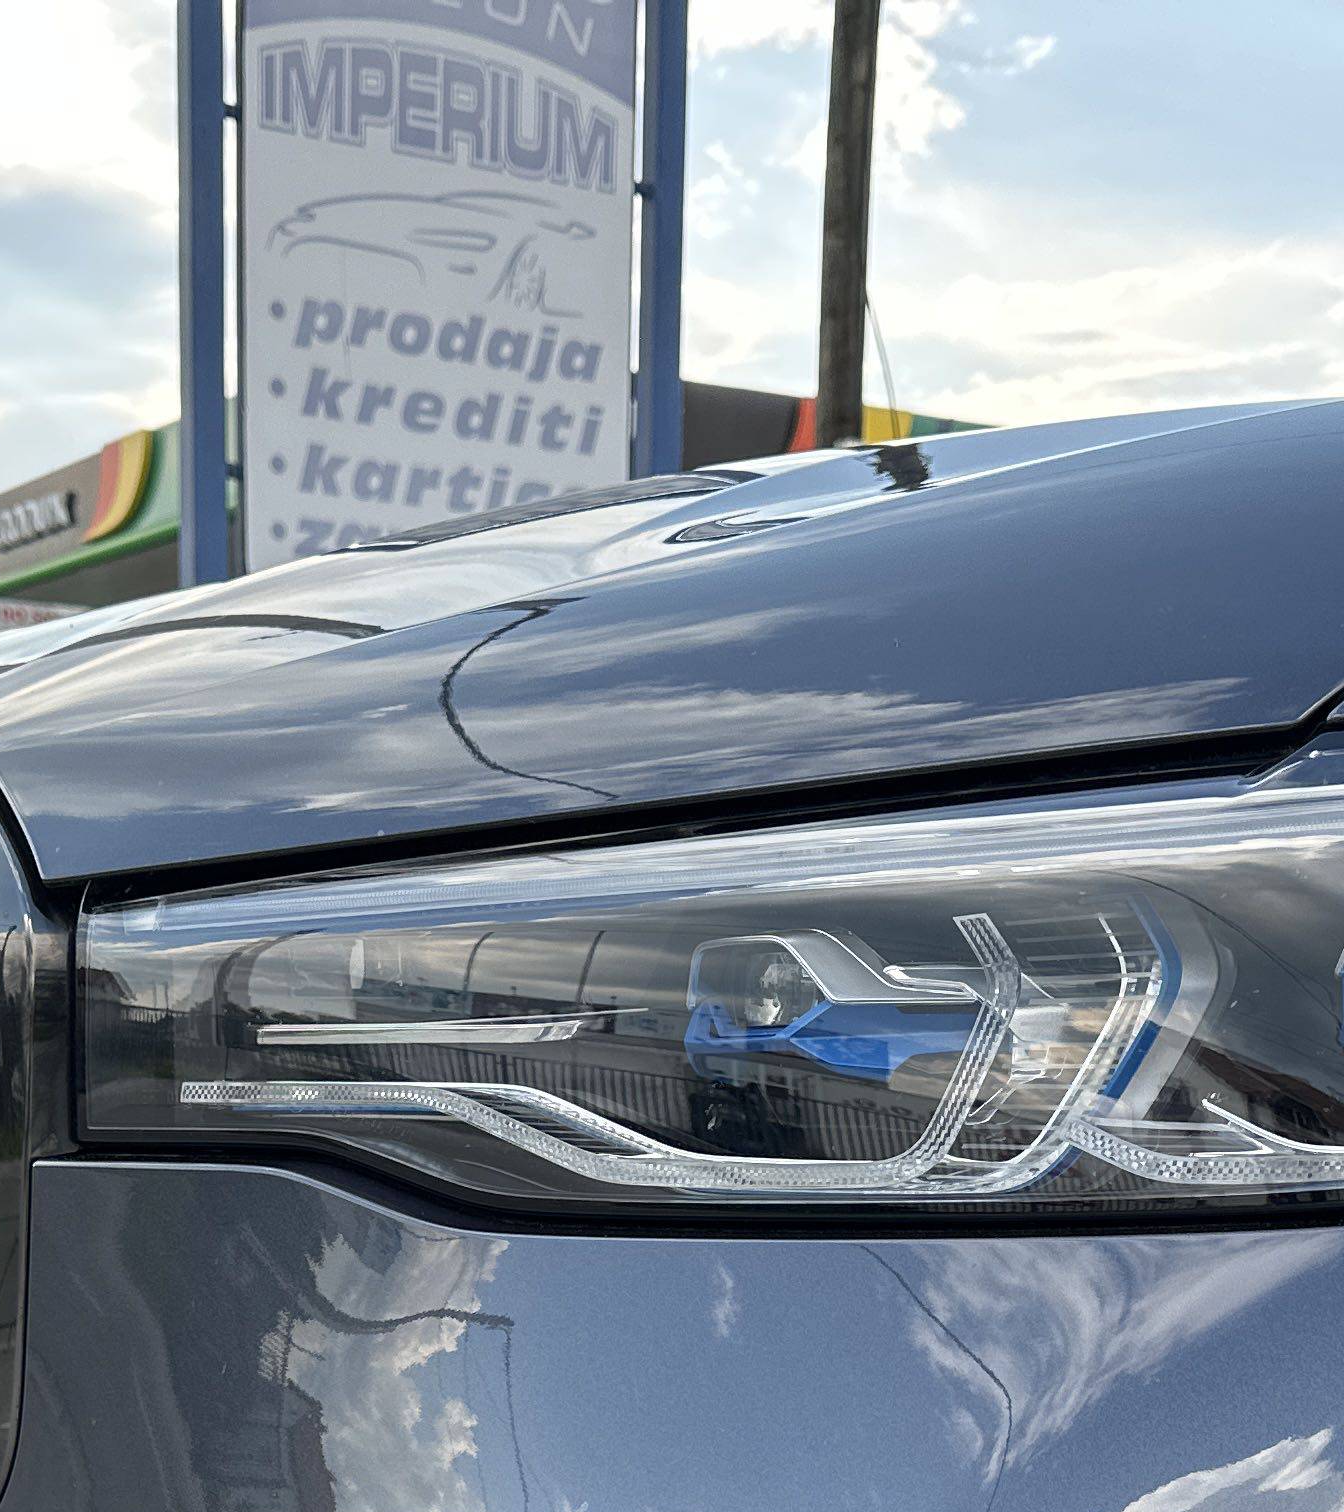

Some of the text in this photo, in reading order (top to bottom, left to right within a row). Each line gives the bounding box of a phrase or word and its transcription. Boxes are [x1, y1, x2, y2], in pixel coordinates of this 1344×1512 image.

[258, 36, 617, 194] IMPERIUM
[295, 298, 603, 382] prodaja
[302, 366, 604, 455] krediti
